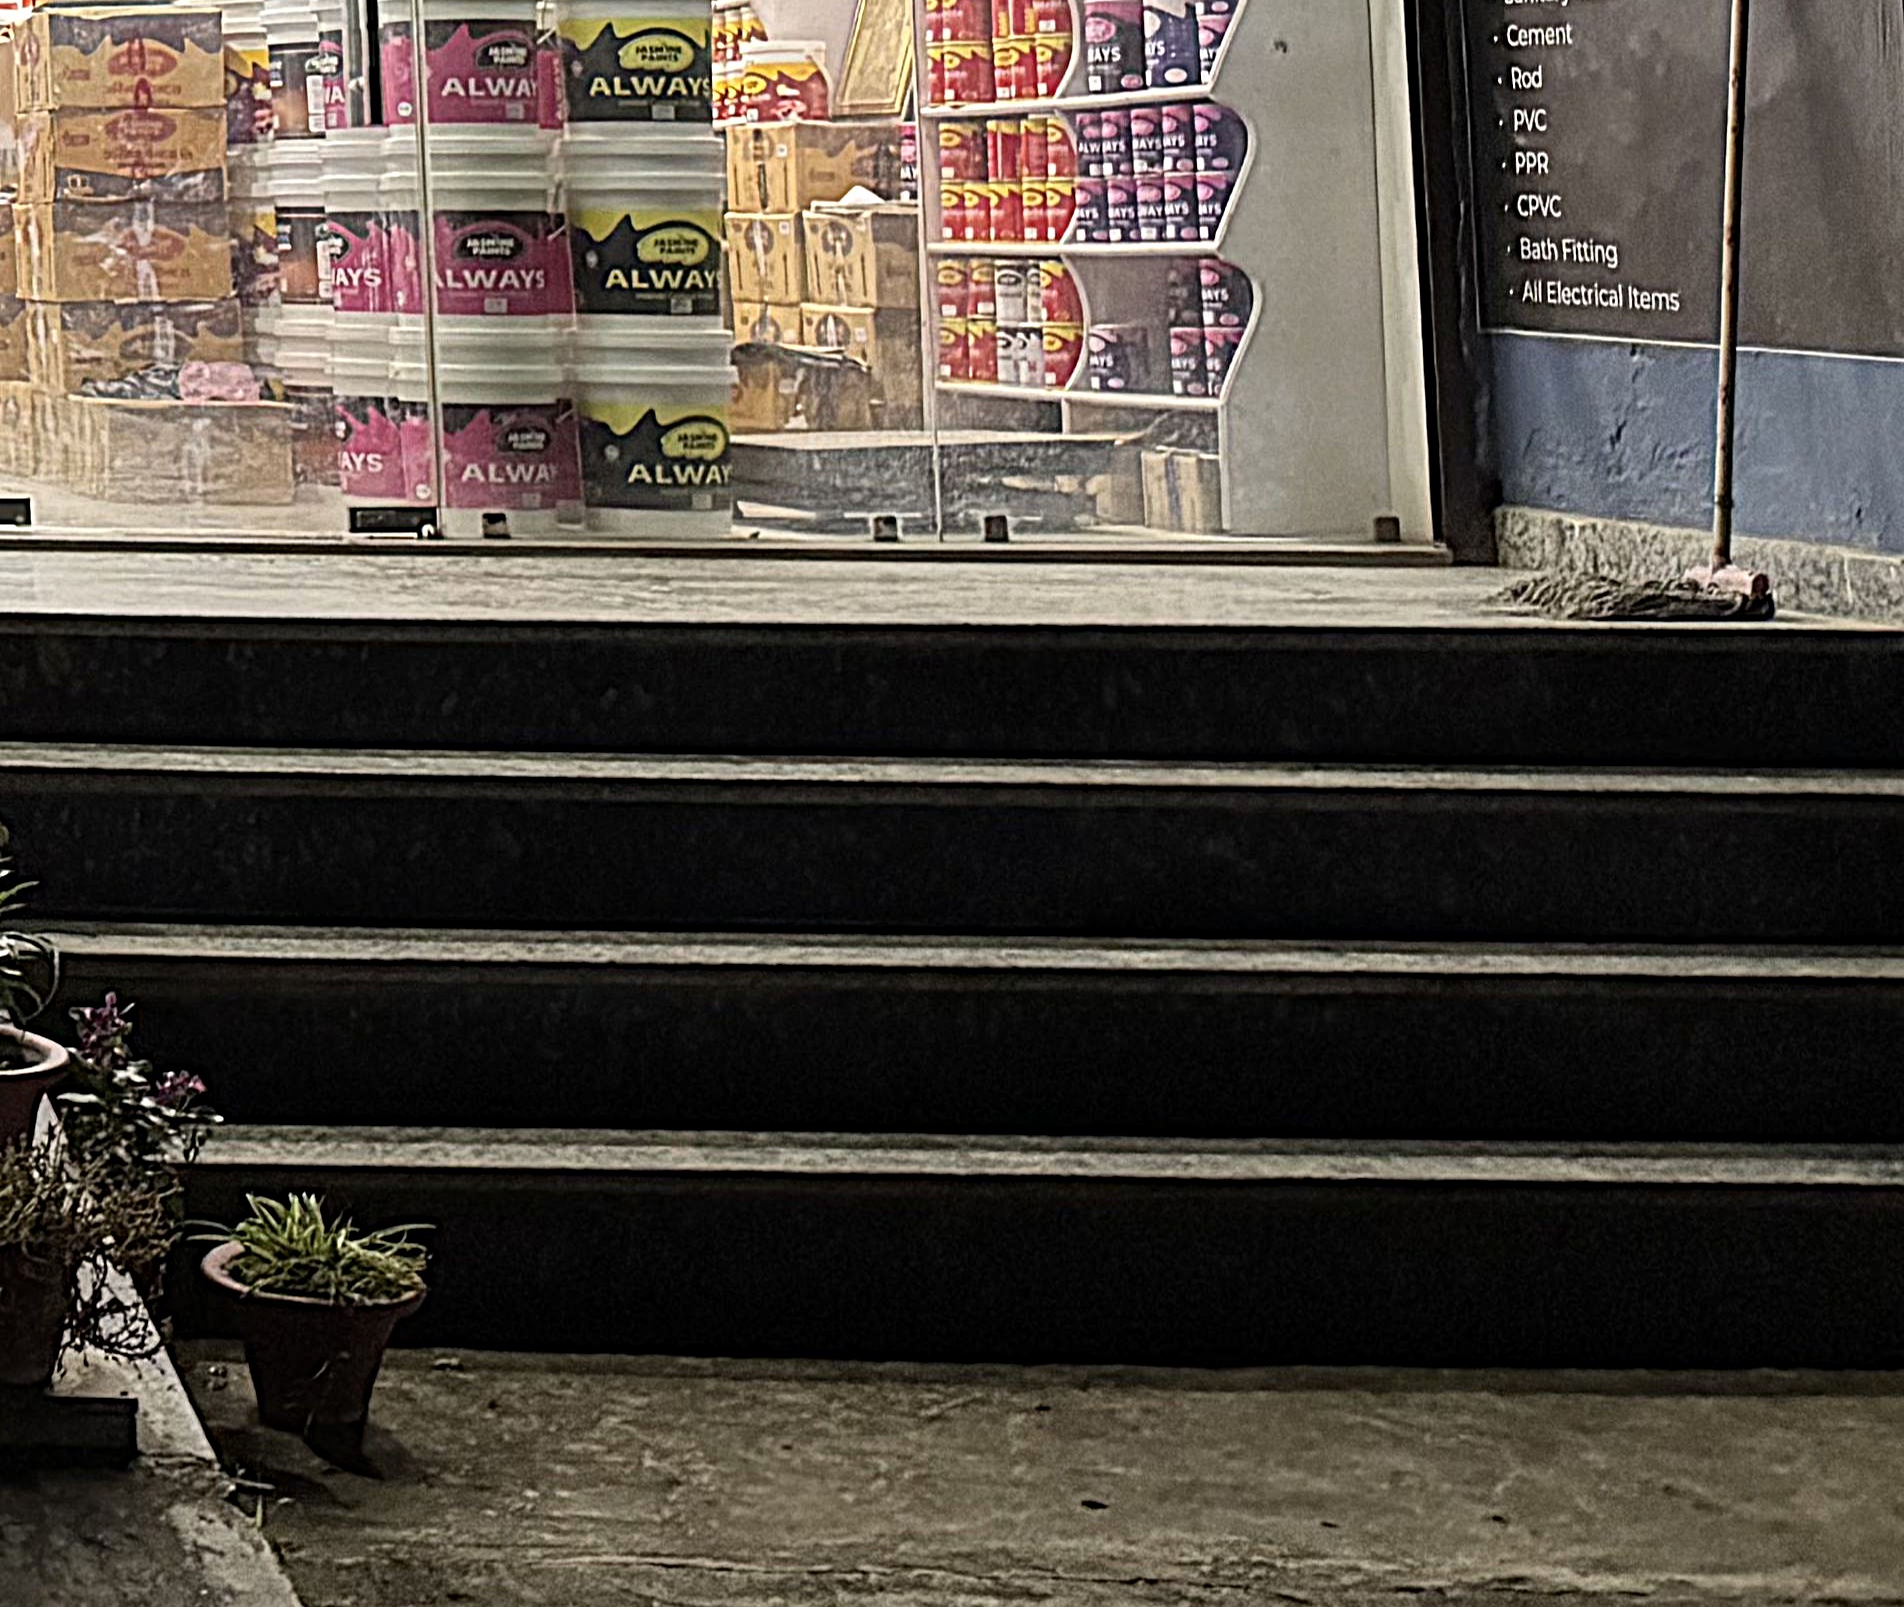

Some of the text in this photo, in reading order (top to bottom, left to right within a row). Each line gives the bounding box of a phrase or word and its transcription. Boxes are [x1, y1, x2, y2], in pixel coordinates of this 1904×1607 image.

[1506, 23, 1573, 48] Cement
[635, 45, 683, 55] JASMINE
[640, 54, 679, 63] PAINTS
[590, 76, 711, 97] ALWAYS
[1511, 65, 1543, 89] Rod
[1513, 109, 1547, 132] PVC
[1514, 152, 1549, 175] PPR
[1516, 195, 1562, 218] CPVC
[1519, 237, 1618, 268] Bath Fitting
[1521, 280, 1681, 311] All Electrical Items
